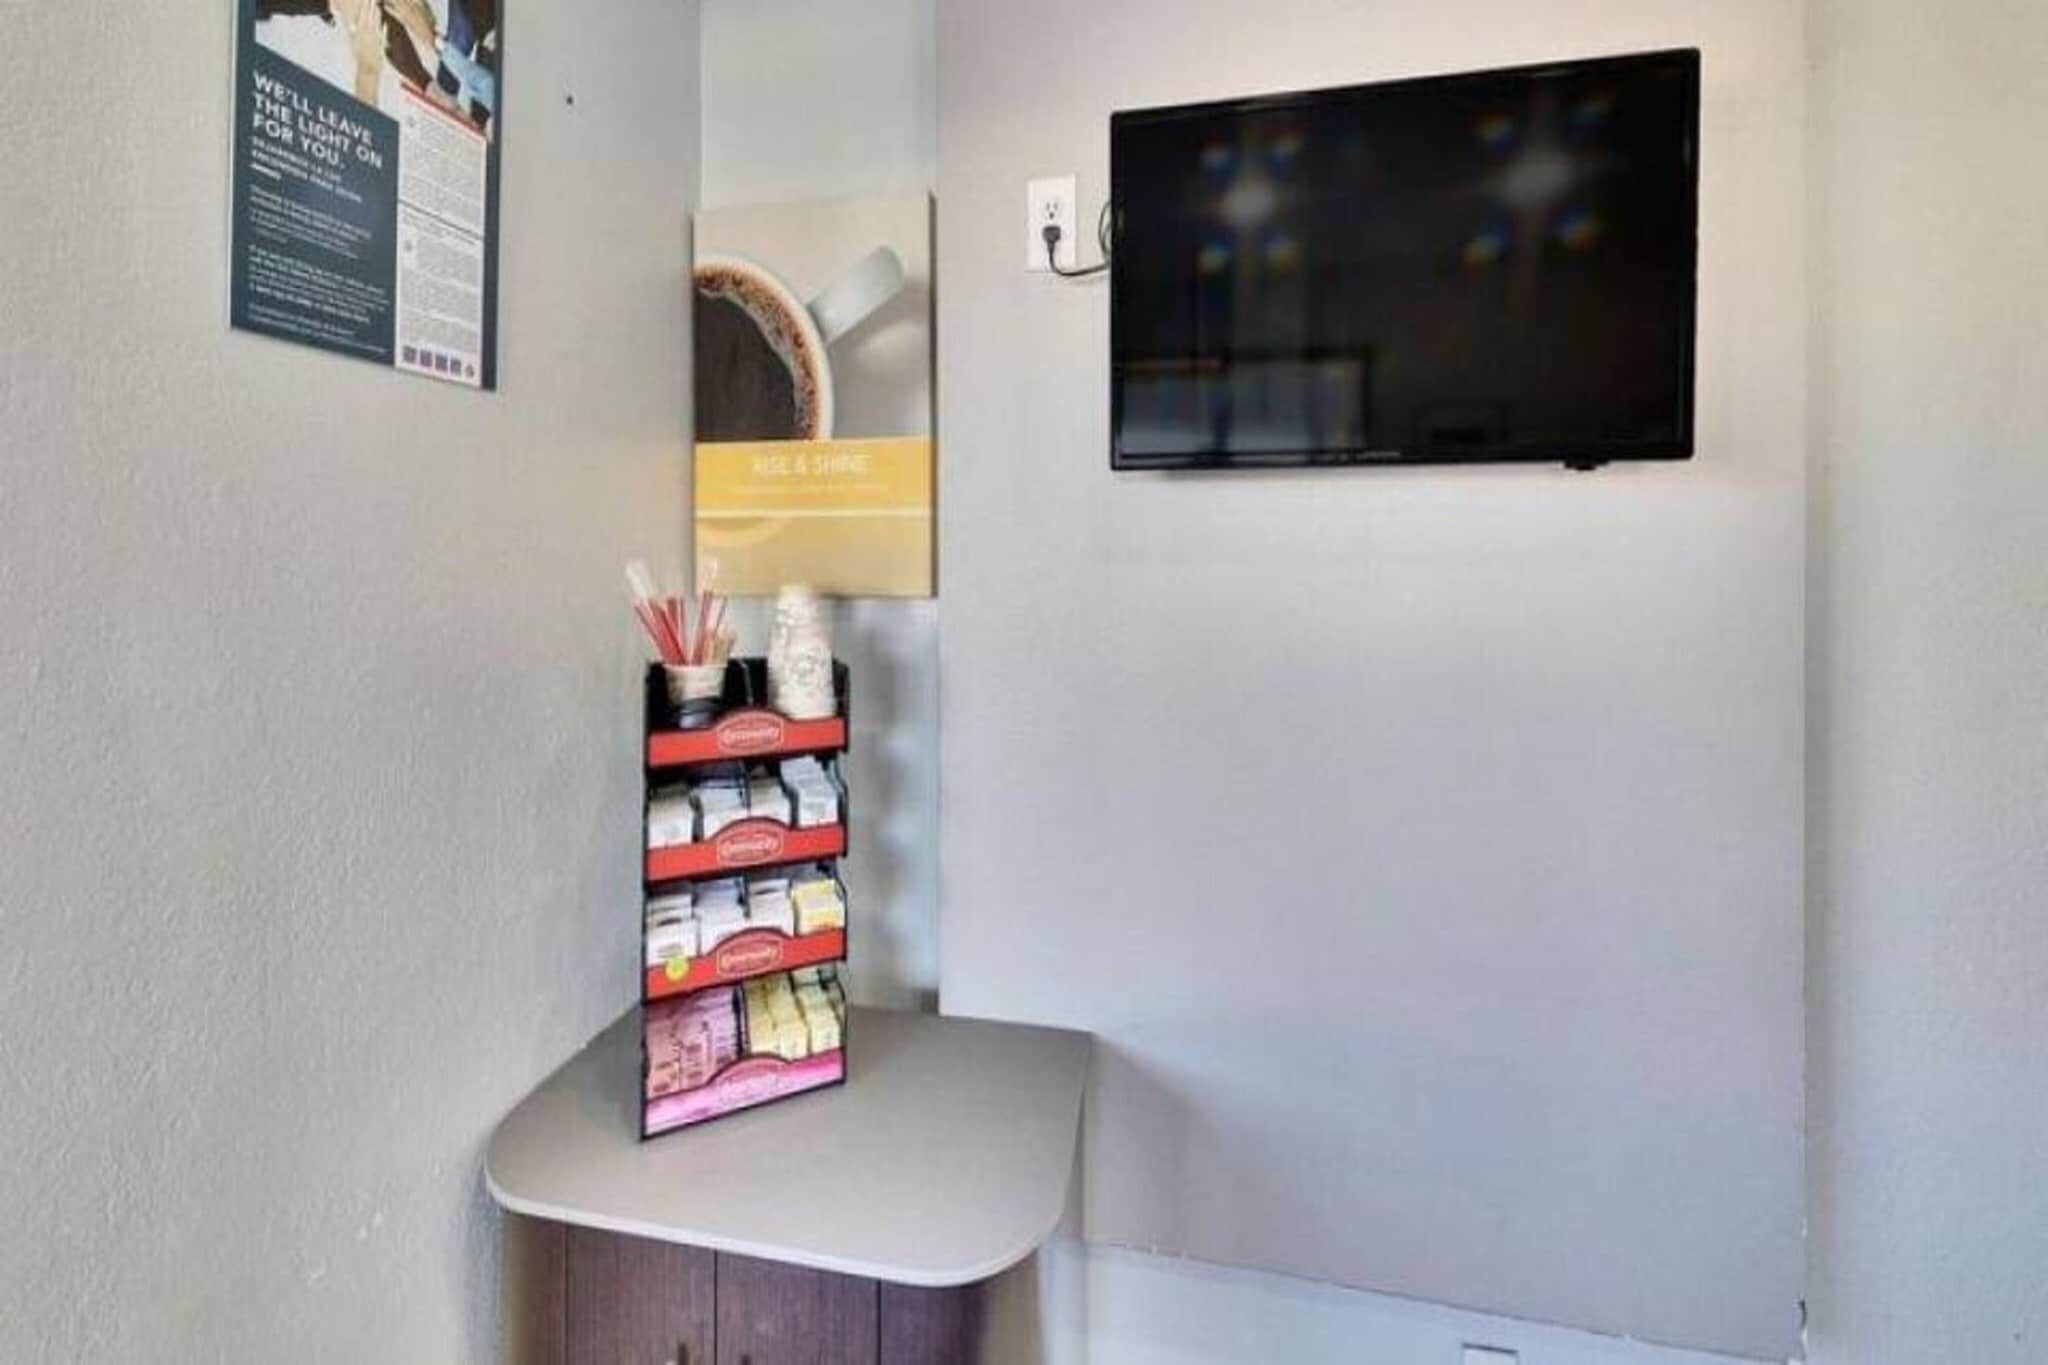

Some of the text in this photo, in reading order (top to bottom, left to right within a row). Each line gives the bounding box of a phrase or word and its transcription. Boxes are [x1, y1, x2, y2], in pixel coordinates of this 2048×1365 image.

[253, 113, 293, 144] FOR
[253, 91, 382, 169] THE LIGHT ON
[254, 72, 372, 146] WE'LL LEAVE
